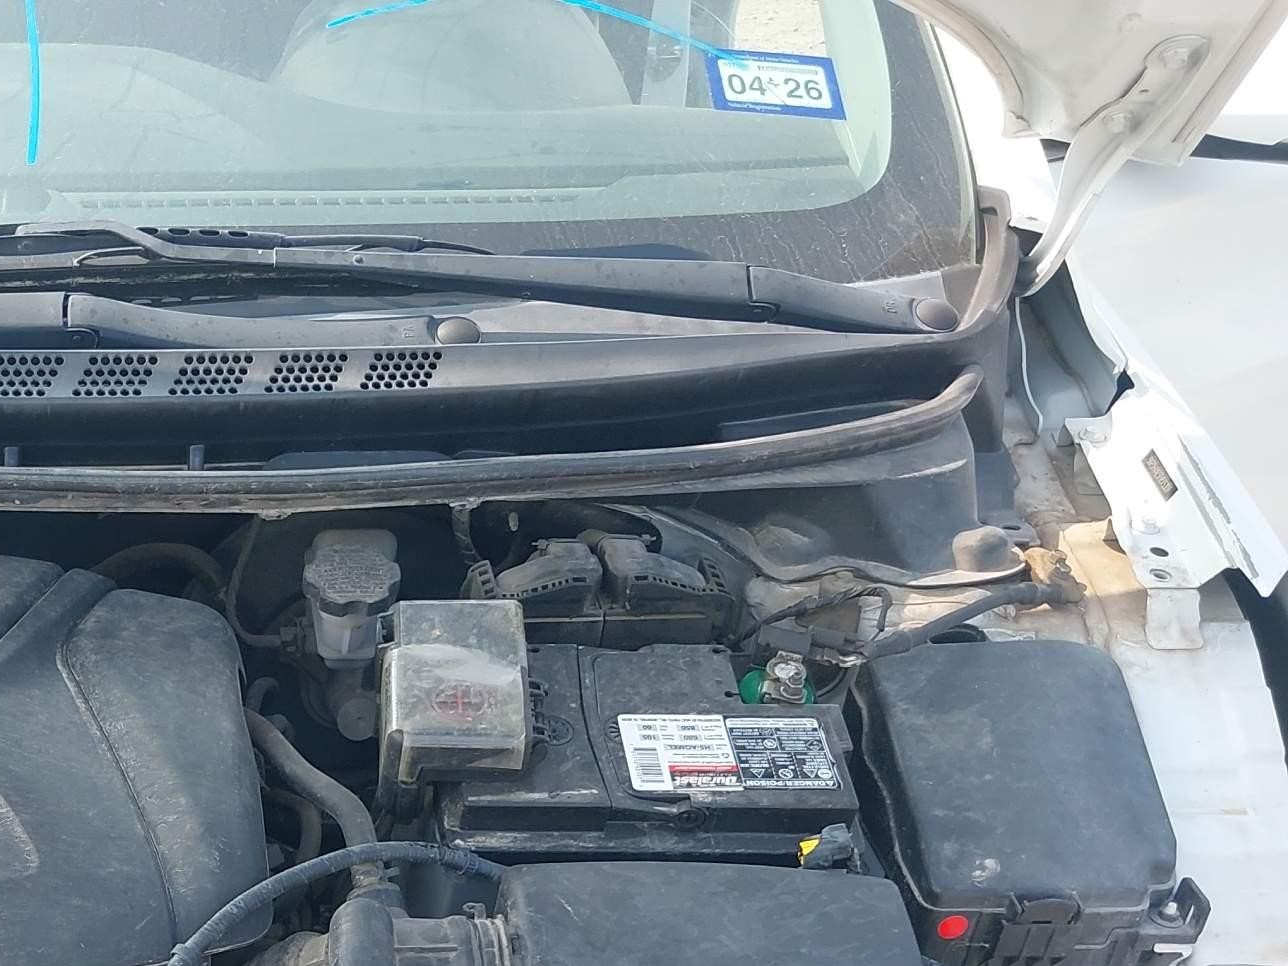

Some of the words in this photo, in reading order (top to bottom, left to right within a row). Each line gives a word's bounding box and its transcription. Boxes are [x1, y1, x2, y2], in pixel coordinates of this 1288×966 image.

[727, 73, 768, 97] 04
[783, 77, 823, 101] 26
[673, 775, 738, 787] Duralast
